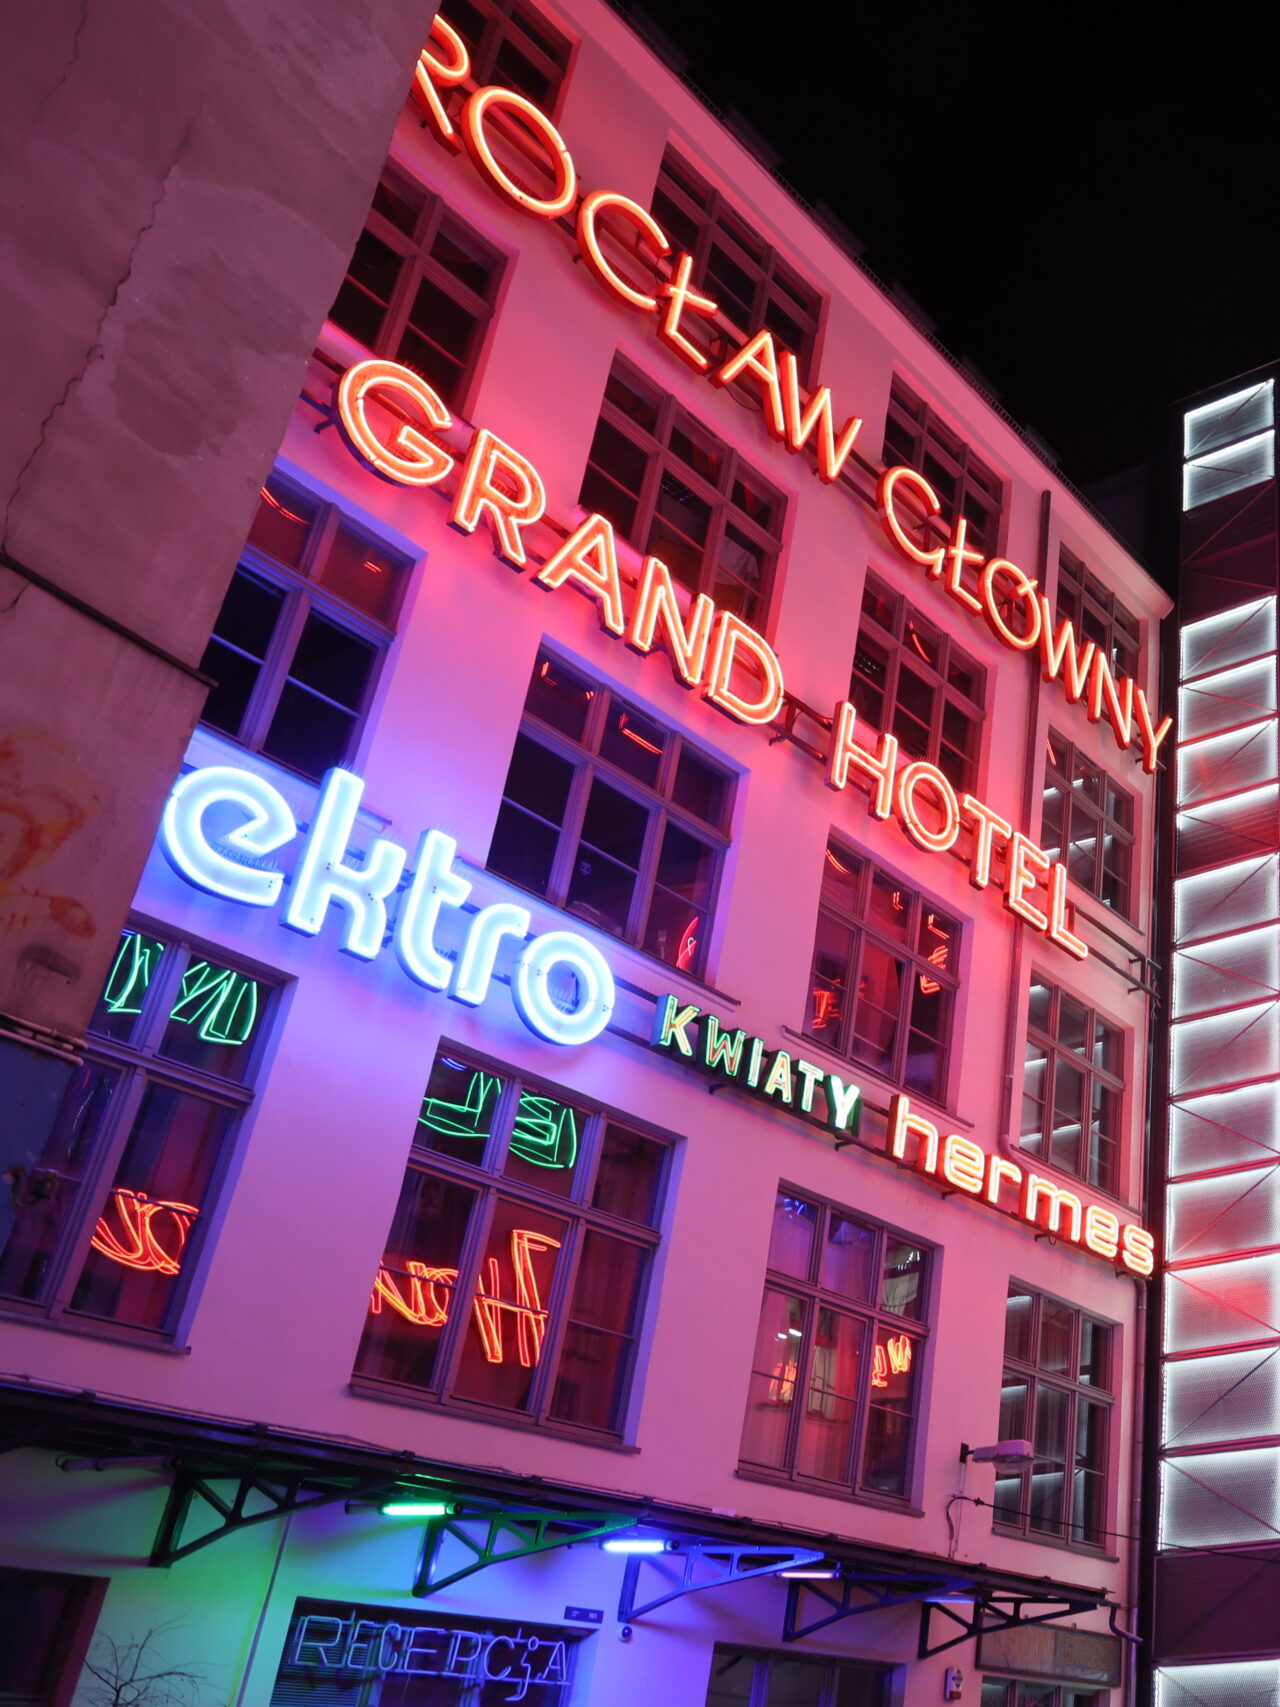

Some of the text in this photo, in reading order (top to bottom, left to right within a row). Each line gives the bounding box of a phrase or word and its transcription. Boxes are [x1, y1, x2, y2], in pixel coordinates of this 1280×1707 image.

[338, 358, 1089, 961] GRAND HOTEL
[159, 765, 615, 1046] ektro
[657, 993, 861, 1133] KWIATY
[891, 1094, 1156, 1278] hermes
